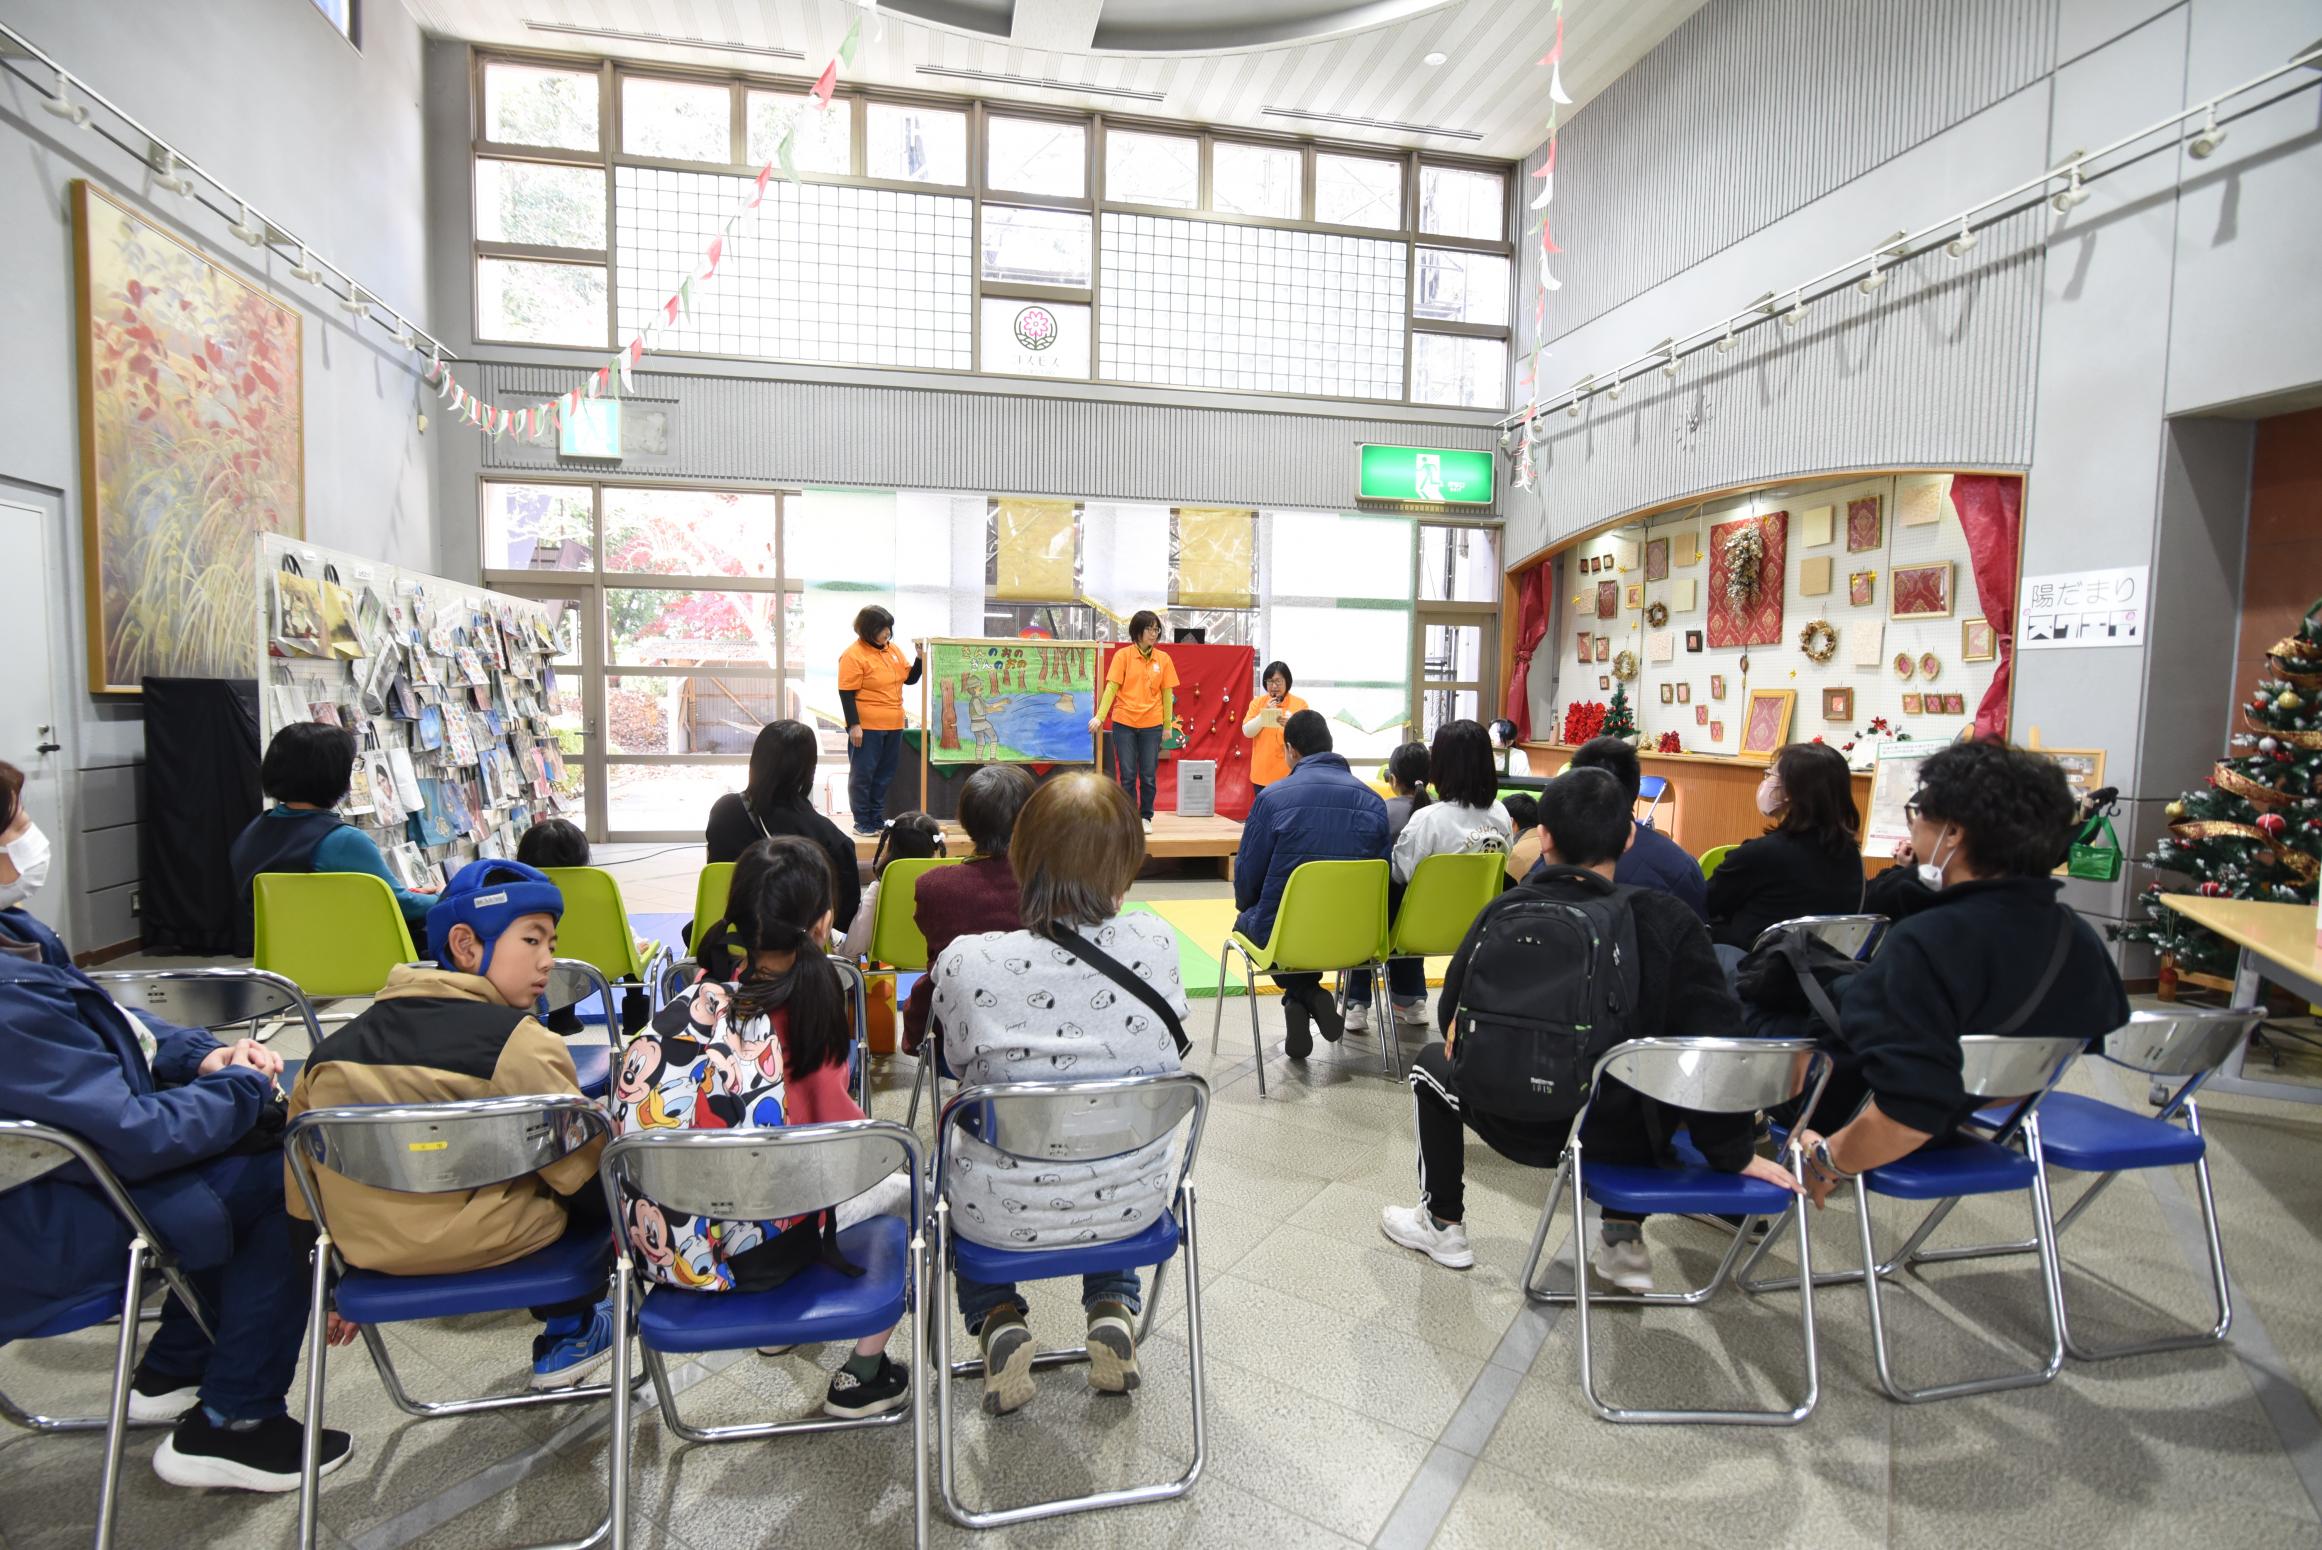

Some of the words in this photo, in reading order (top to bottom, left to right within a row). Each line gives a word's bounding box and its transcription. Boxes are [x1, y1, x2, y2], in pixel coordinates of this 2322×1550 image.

[2031, 577, 2136, 609] 陽だまり
[961, 646, 1024, 659] きんのおの
